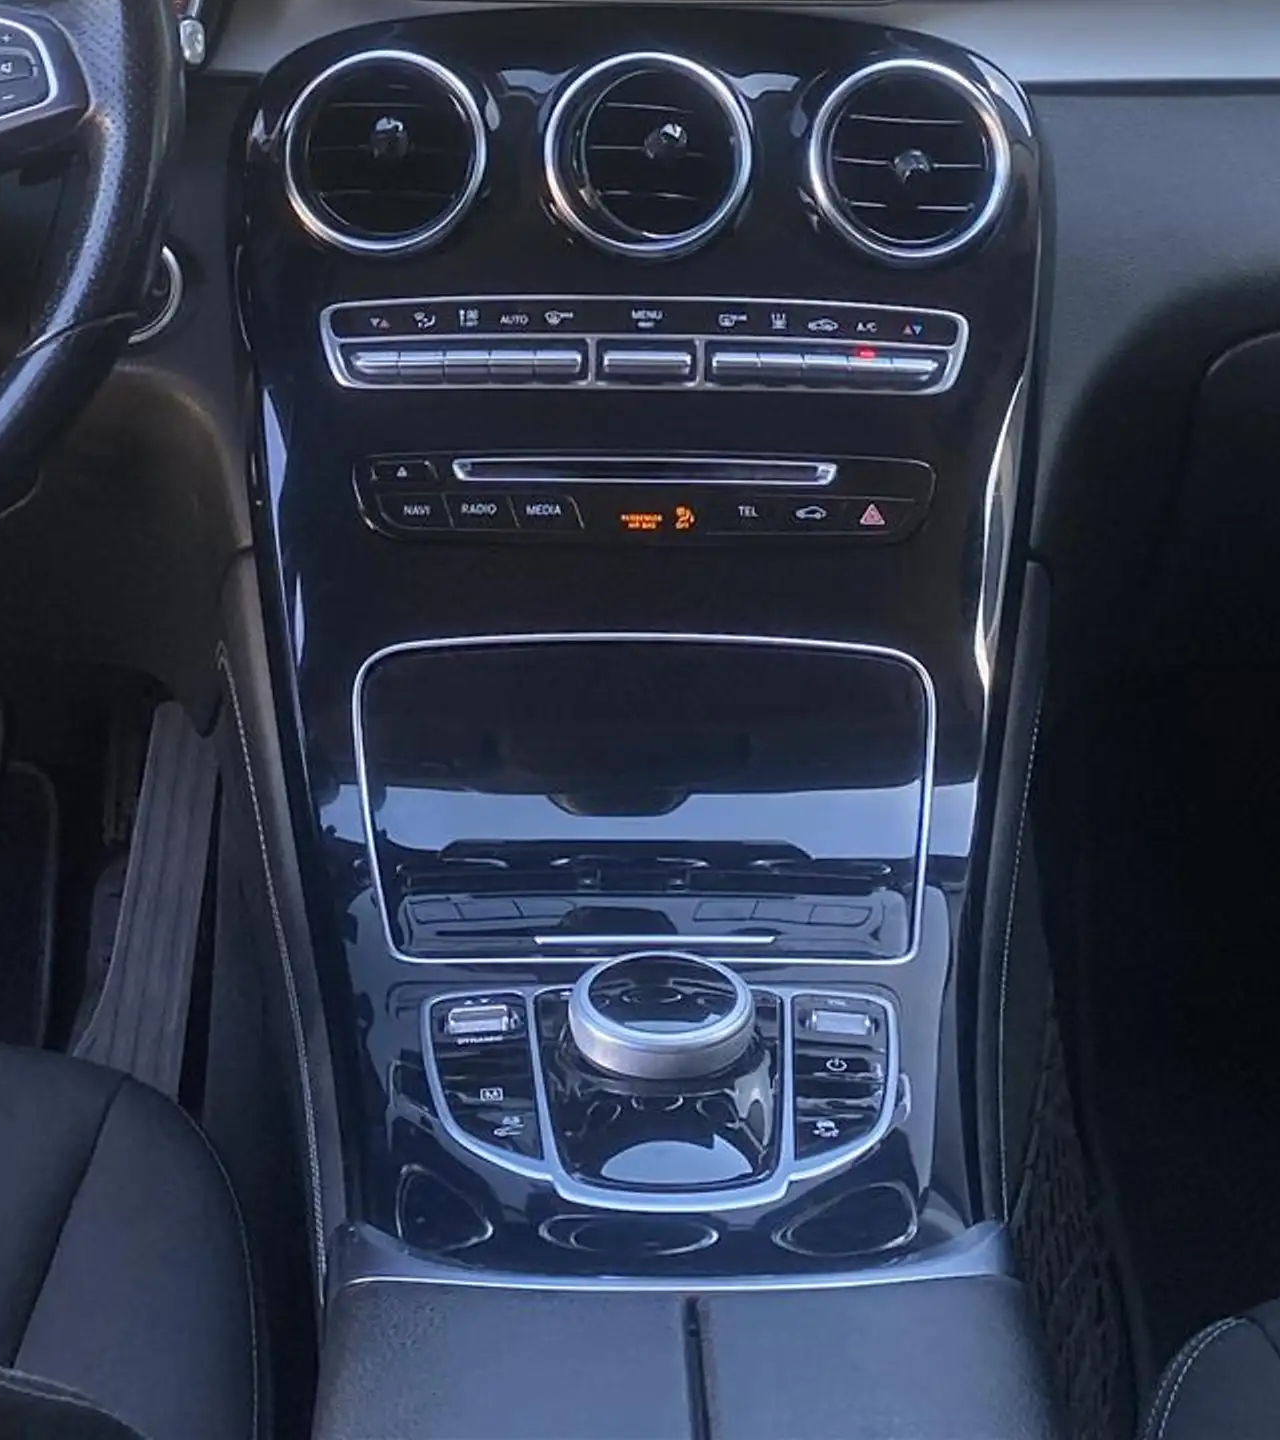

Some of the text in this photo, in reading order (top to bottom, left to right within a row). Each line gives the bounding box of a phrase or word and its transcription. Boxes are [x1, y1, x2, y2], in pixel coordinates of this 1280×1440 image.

[500, 315, 528, 325] AUTO
[631, 310, 663, 320] MENU
[856, 322, 877, 332] A/C
[403, 505, 431, 515] NAVI
[461, 504, 497, 515] RADIO
[526, 504, 561, 515] MEDIA
[738, 506, 758, 516] TEL
